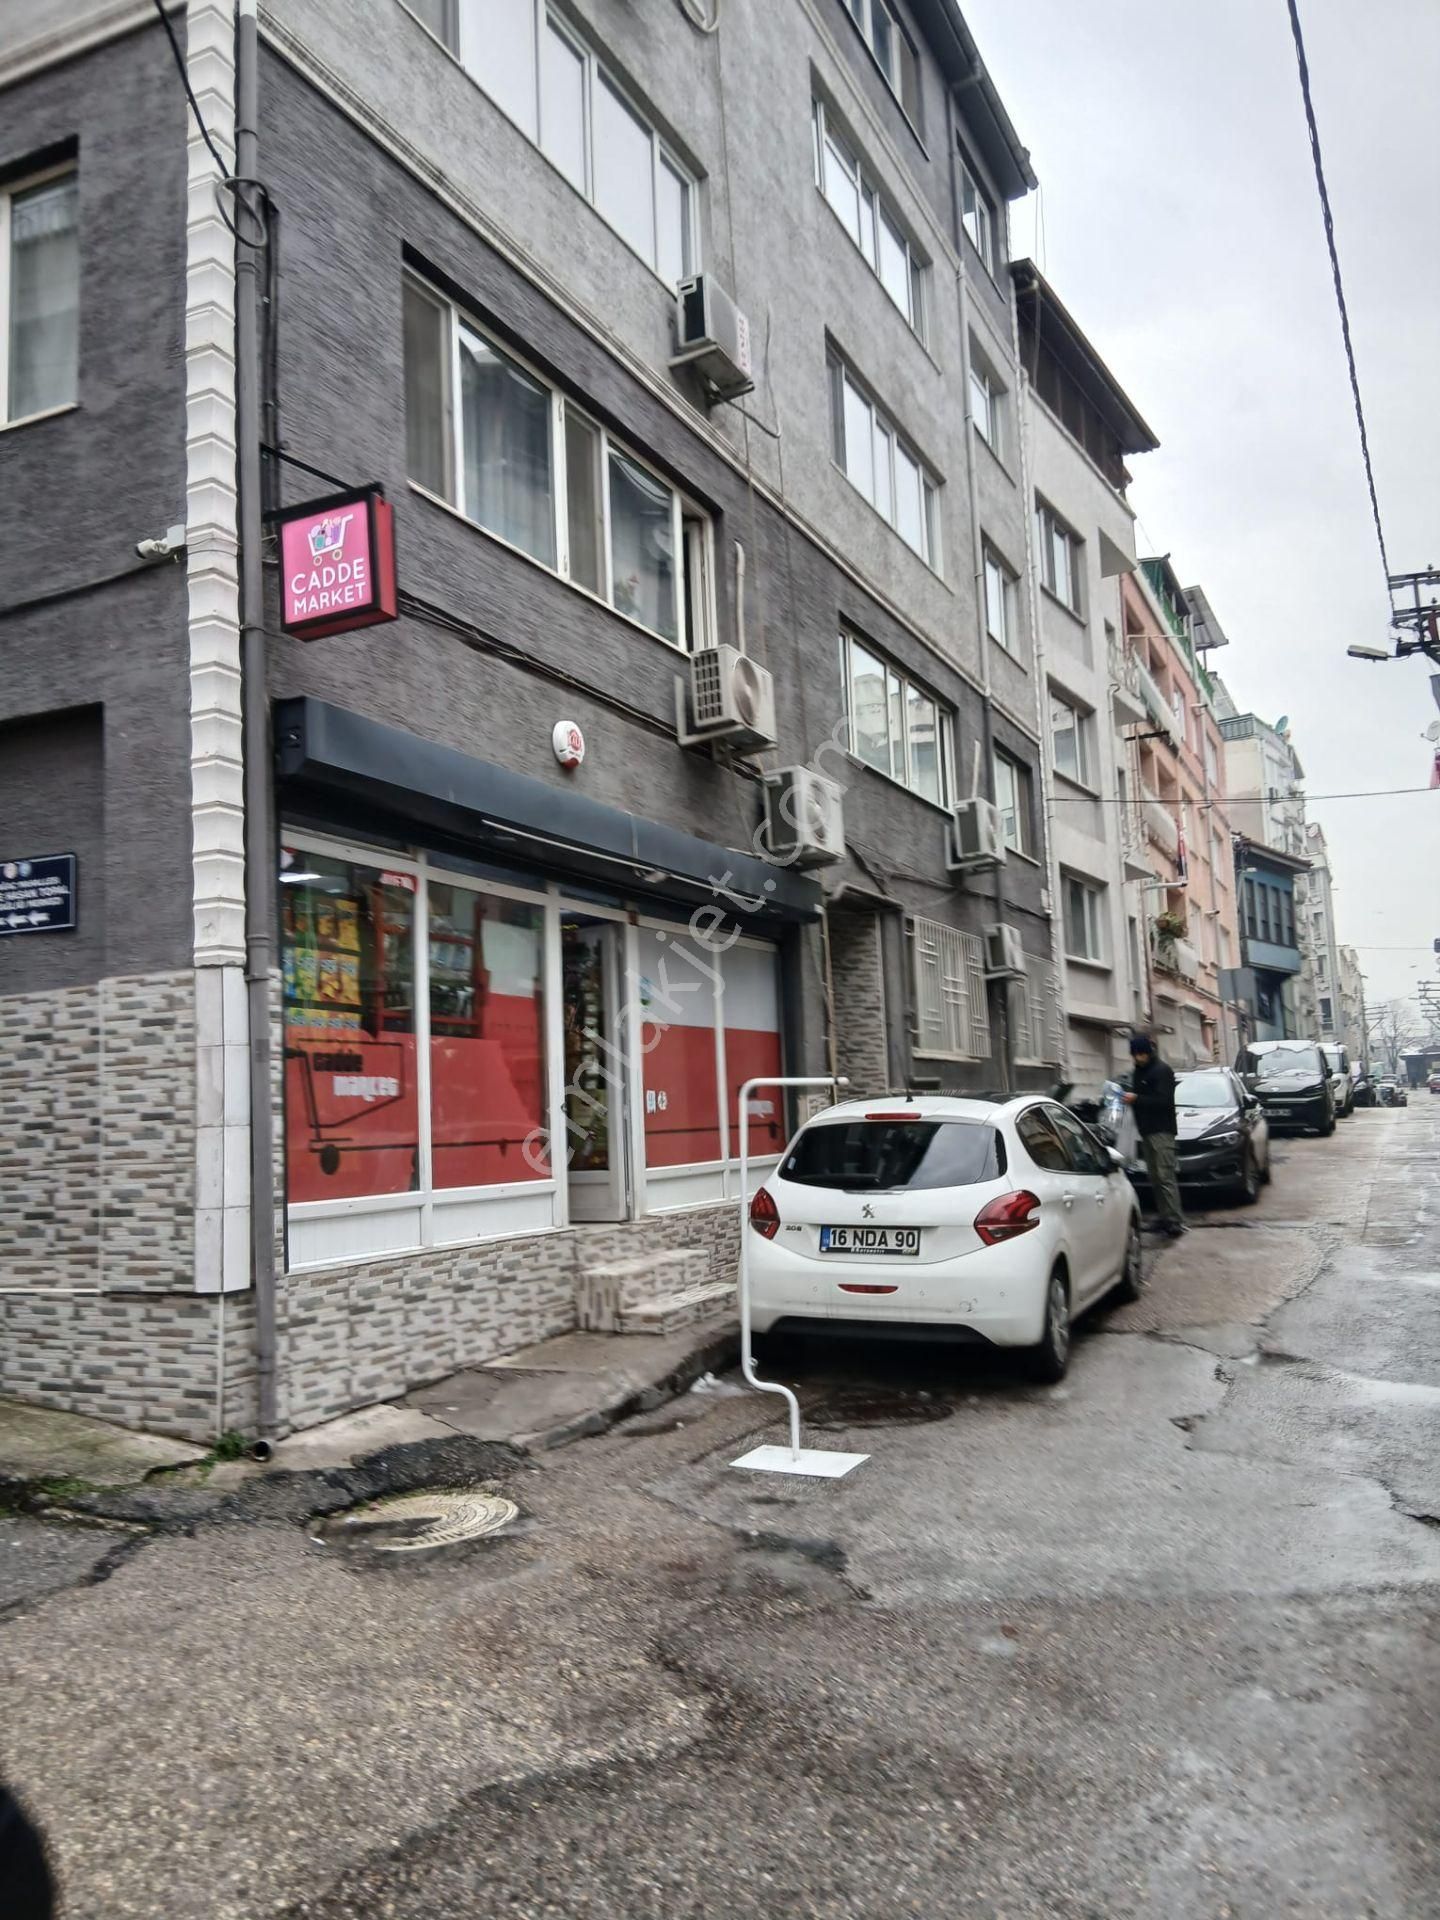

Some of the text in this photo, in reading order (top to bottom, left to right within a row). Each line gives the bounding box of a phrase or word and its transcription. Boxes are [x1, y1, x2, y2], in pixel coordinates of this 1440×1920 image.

[291, 557, 365, 594] CADDE
[294, 582, 366, 615] MARKET
[831, 1229, 916, 1248] 16 NDA 90
